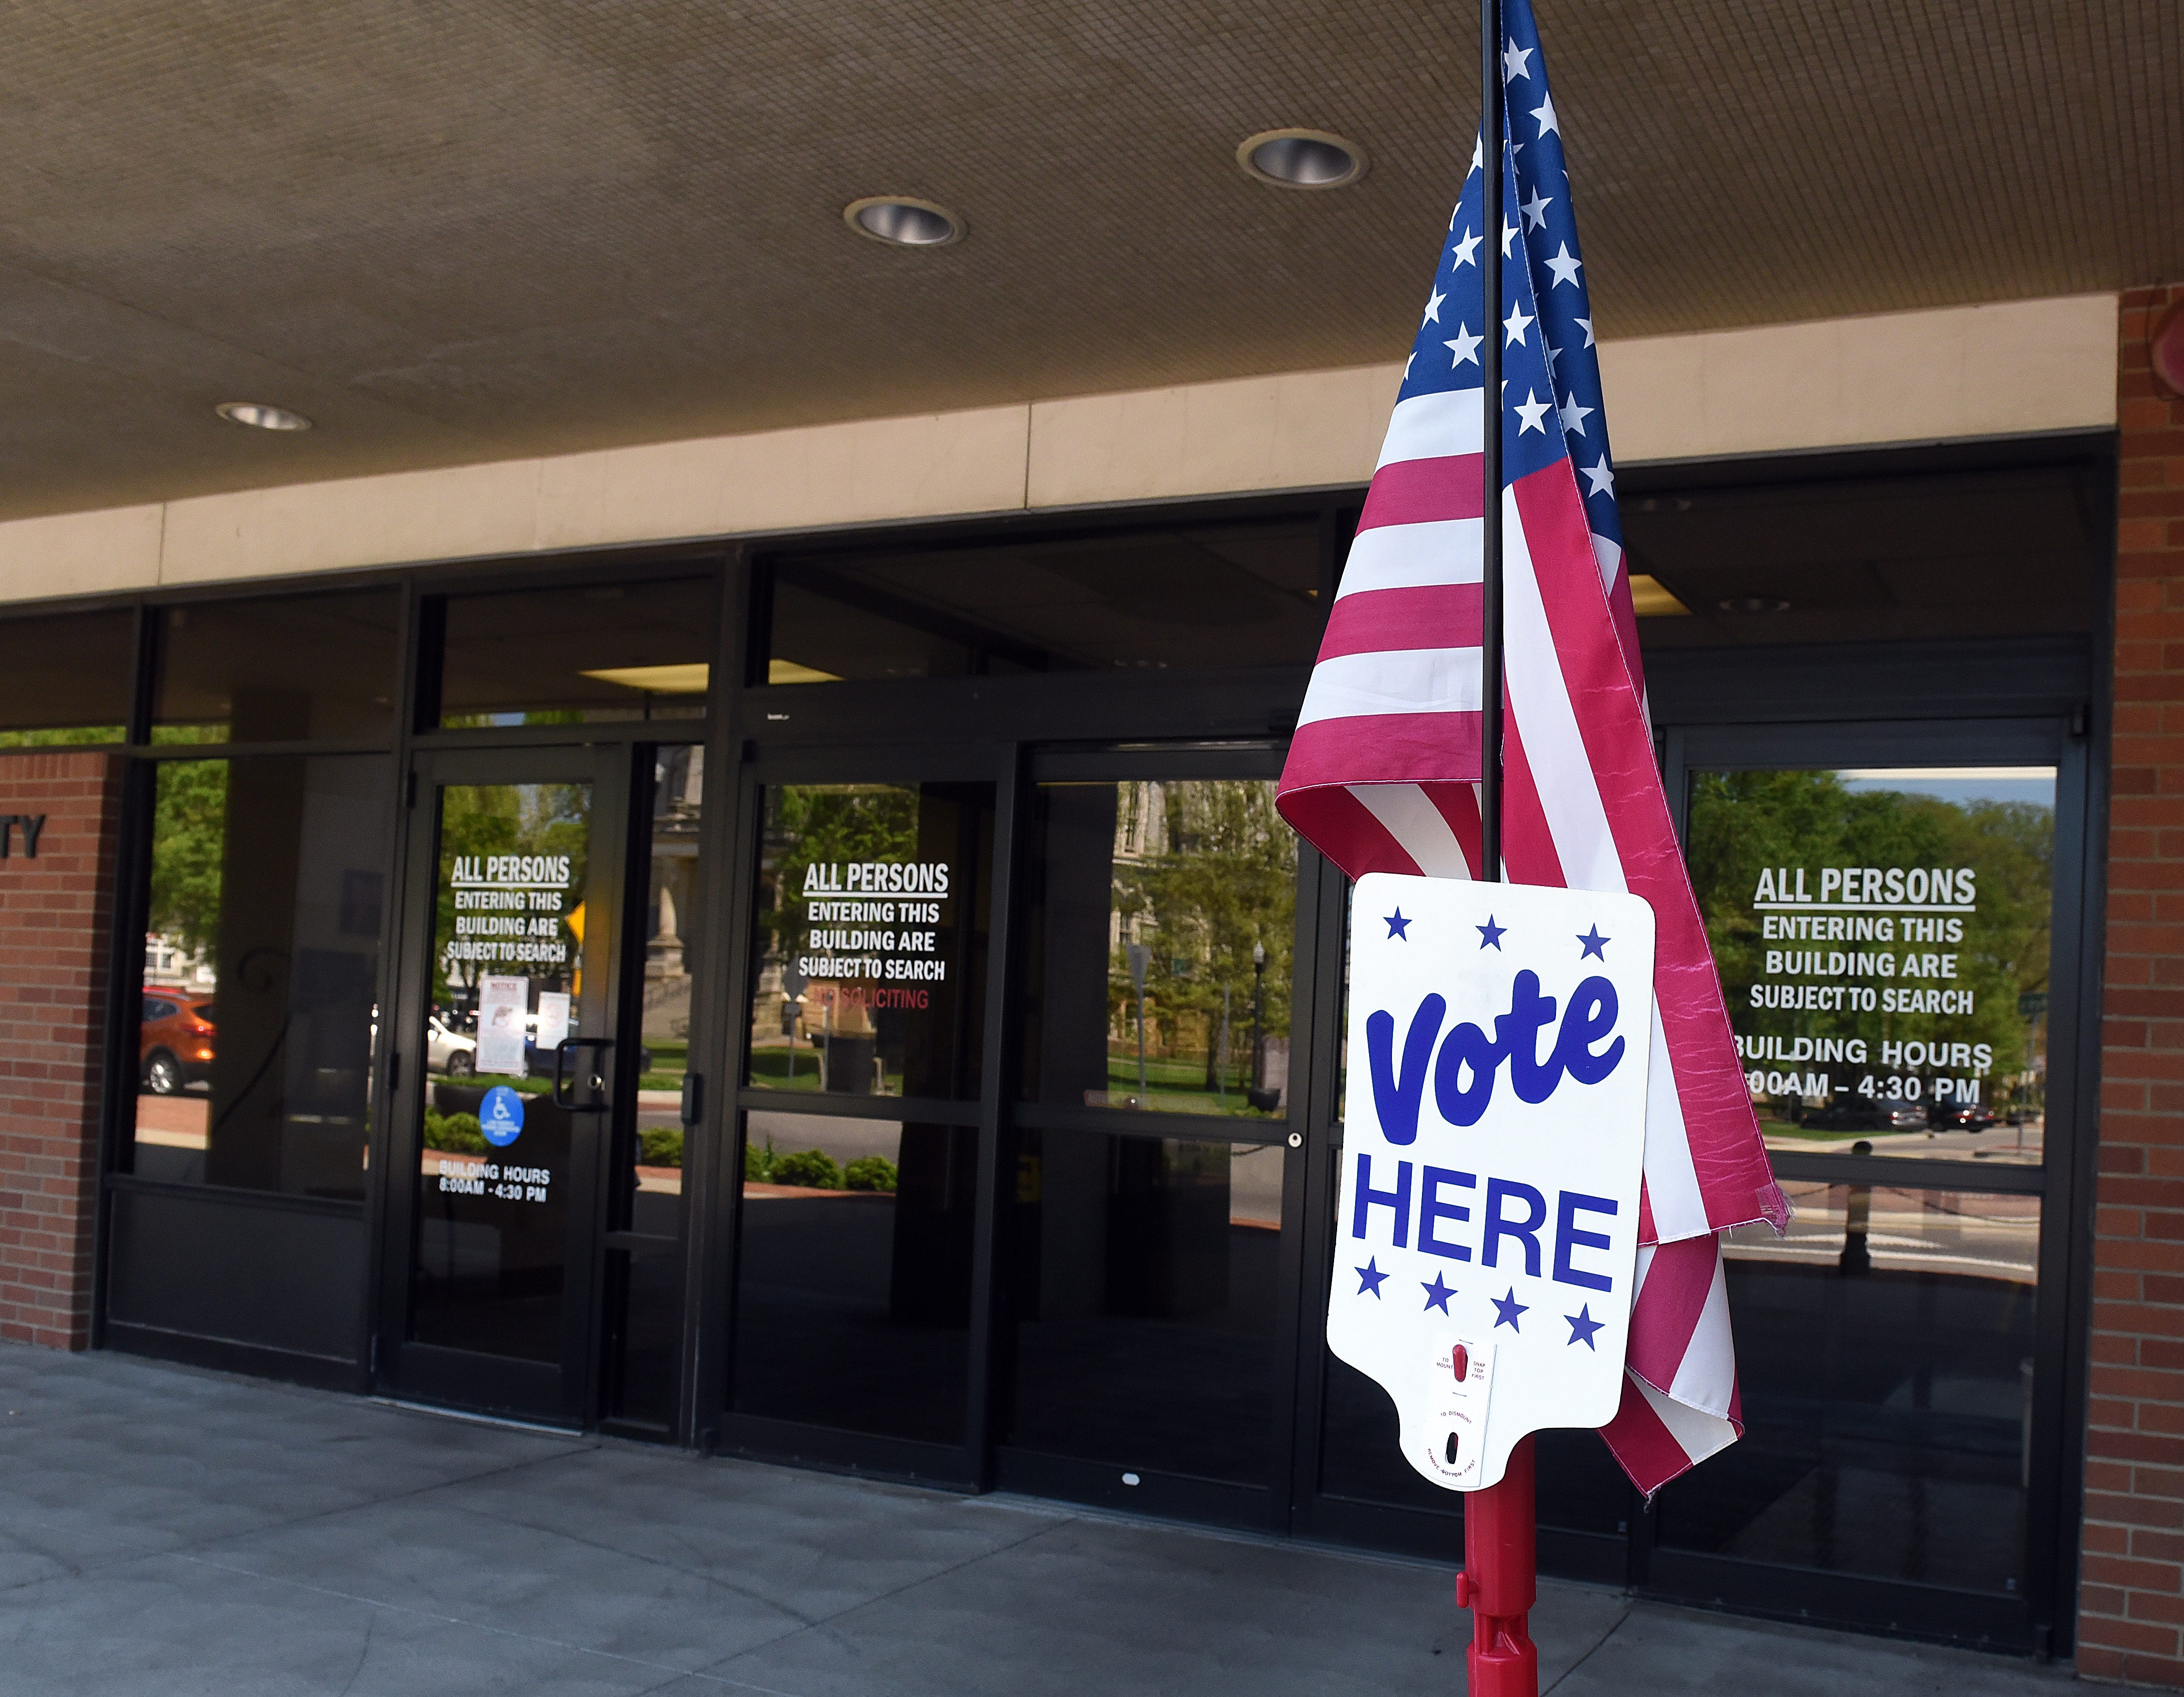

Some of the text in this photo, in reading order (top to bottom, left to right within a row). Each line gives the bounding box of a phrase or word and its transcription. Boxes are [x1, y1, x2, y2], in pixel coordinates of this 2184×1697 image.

[452, 856, 571, 883] ALL PERSONS
[803, 862, 949, 892] ALL PERSONS
[1754, 868, 1976, 904] ALL PERSONS
[455, 892, 562, 911] ENTERING THIS
[808, 902, 940, 923] ENTERING THIS
[455, 917, 558, 937] BUILDING ARE
[1763, 915, 1964, 943] ENTERING THIS
[446, 941, 567, 962] SUBJECT TO SEARCH
[809, 929, 936, 952] BUILDING ARE
[798, 957, 945, 981] SUBJECT TO SEARCH
[1766, 950, 1958, 978] BUILDING ARE
[841, 987, 929, 1009] SOLICITING
[1750, 984, 1974, 1014] SUBJECT TO SEARCH
[1366, 969, 1625, 1145] Vote
[1881, 1040, 1993, 1070] HOURS
[1857, 1075, 1922, 1102] 4:30
[1934, 1077, 1981, 1104] PM
[439, 1160, 551, 1184] BUILDING HOURS
[439, 1177, 485, 1195] 8:00AM
[495, 1184, 523, 1200] 4:30
[526, 1187, 546, 1203] PM
[1352, 1153, 1618, 1293] HERE
[1449, 1411, 1472, 1424] DISMOUNT
[1427, 1449, 1440, 1470] REMOVE
[1464, 1459, 1476, 1474] FIRST
